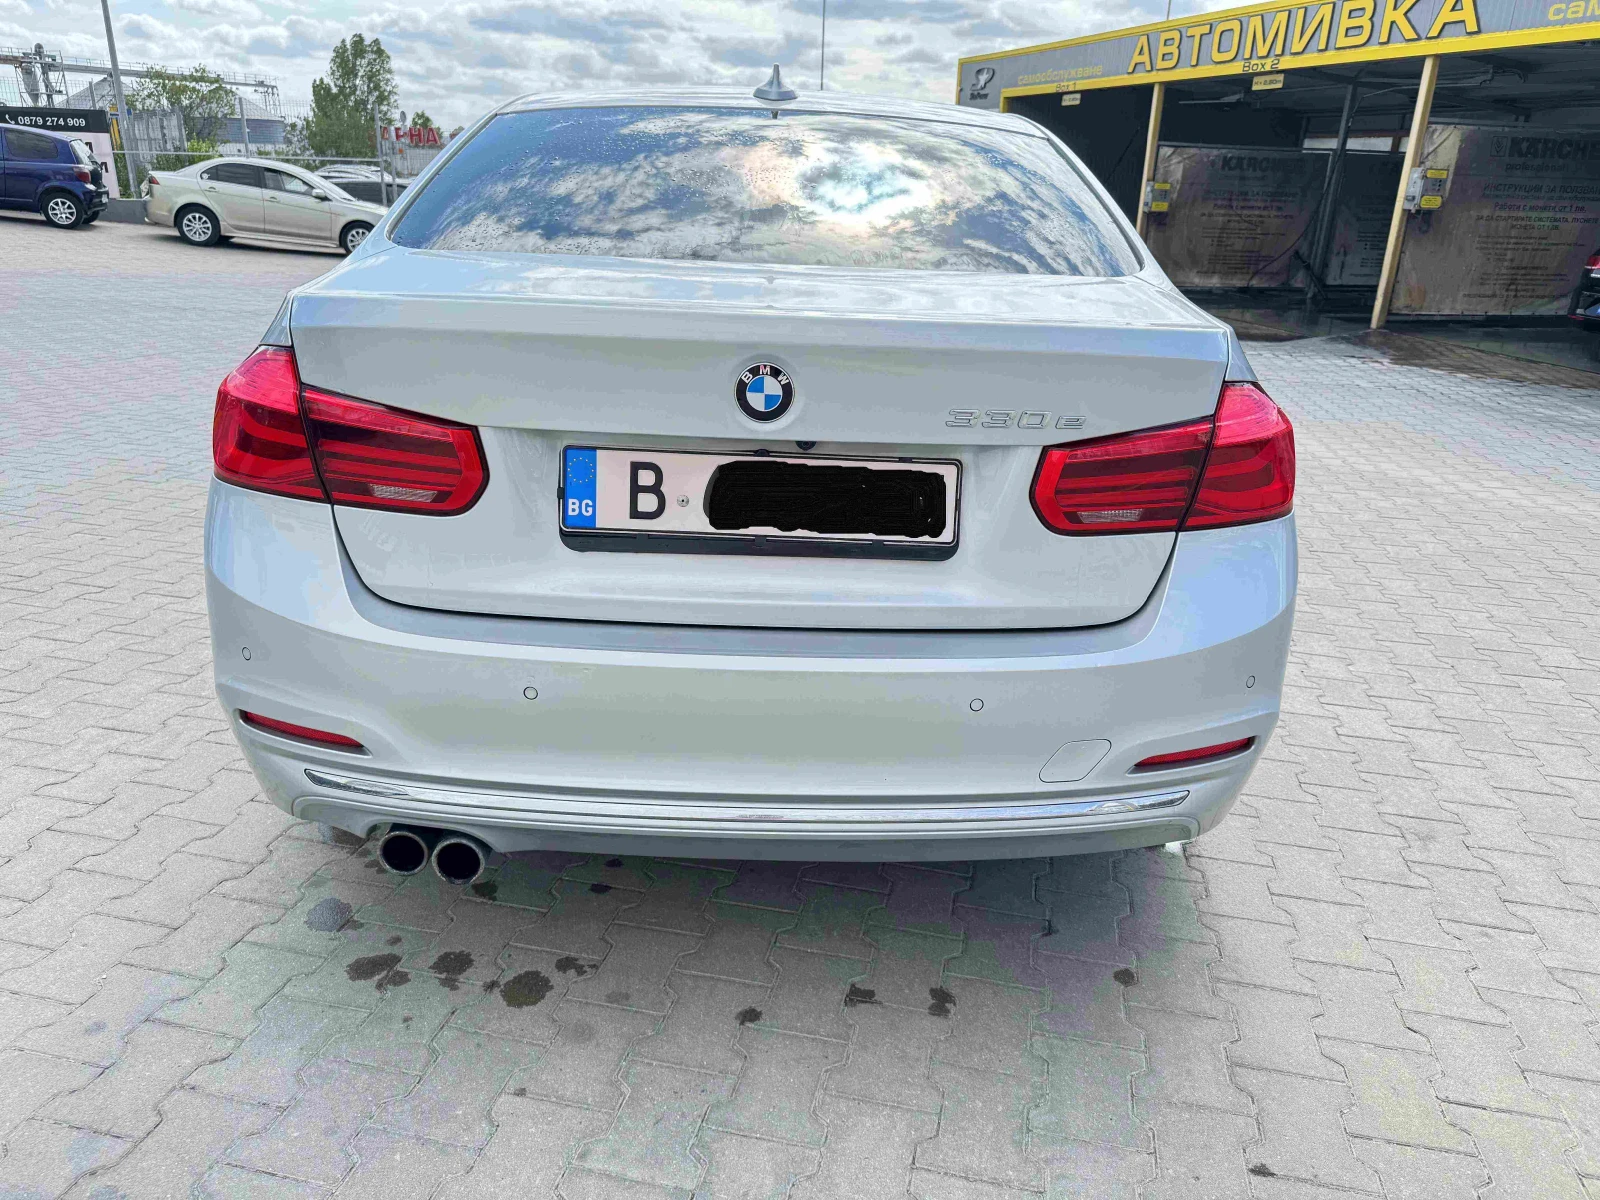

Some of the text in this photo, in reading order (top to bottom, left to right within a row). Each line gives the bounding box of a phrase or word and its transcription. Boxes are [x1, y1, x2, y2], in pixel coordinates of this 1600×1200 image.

[1127, 0, 1480, 73] АВТОМИВКА
[1242, 59, 1280, 72] Box 2
[1018, 65, 1103, 85] самообслужване
[1056, 82, 1077, 92] Box 1
[18, 116, 86, 126] 0879 274 909
[1483, 183, 1543, 194] ИНСТРУКЦИИ
[1494, 202, 1521, 210] Работи
[741, 364, 789, 385] BMW
[629, 461, 666, 519] B
[568, 499, 593, 516] BG
